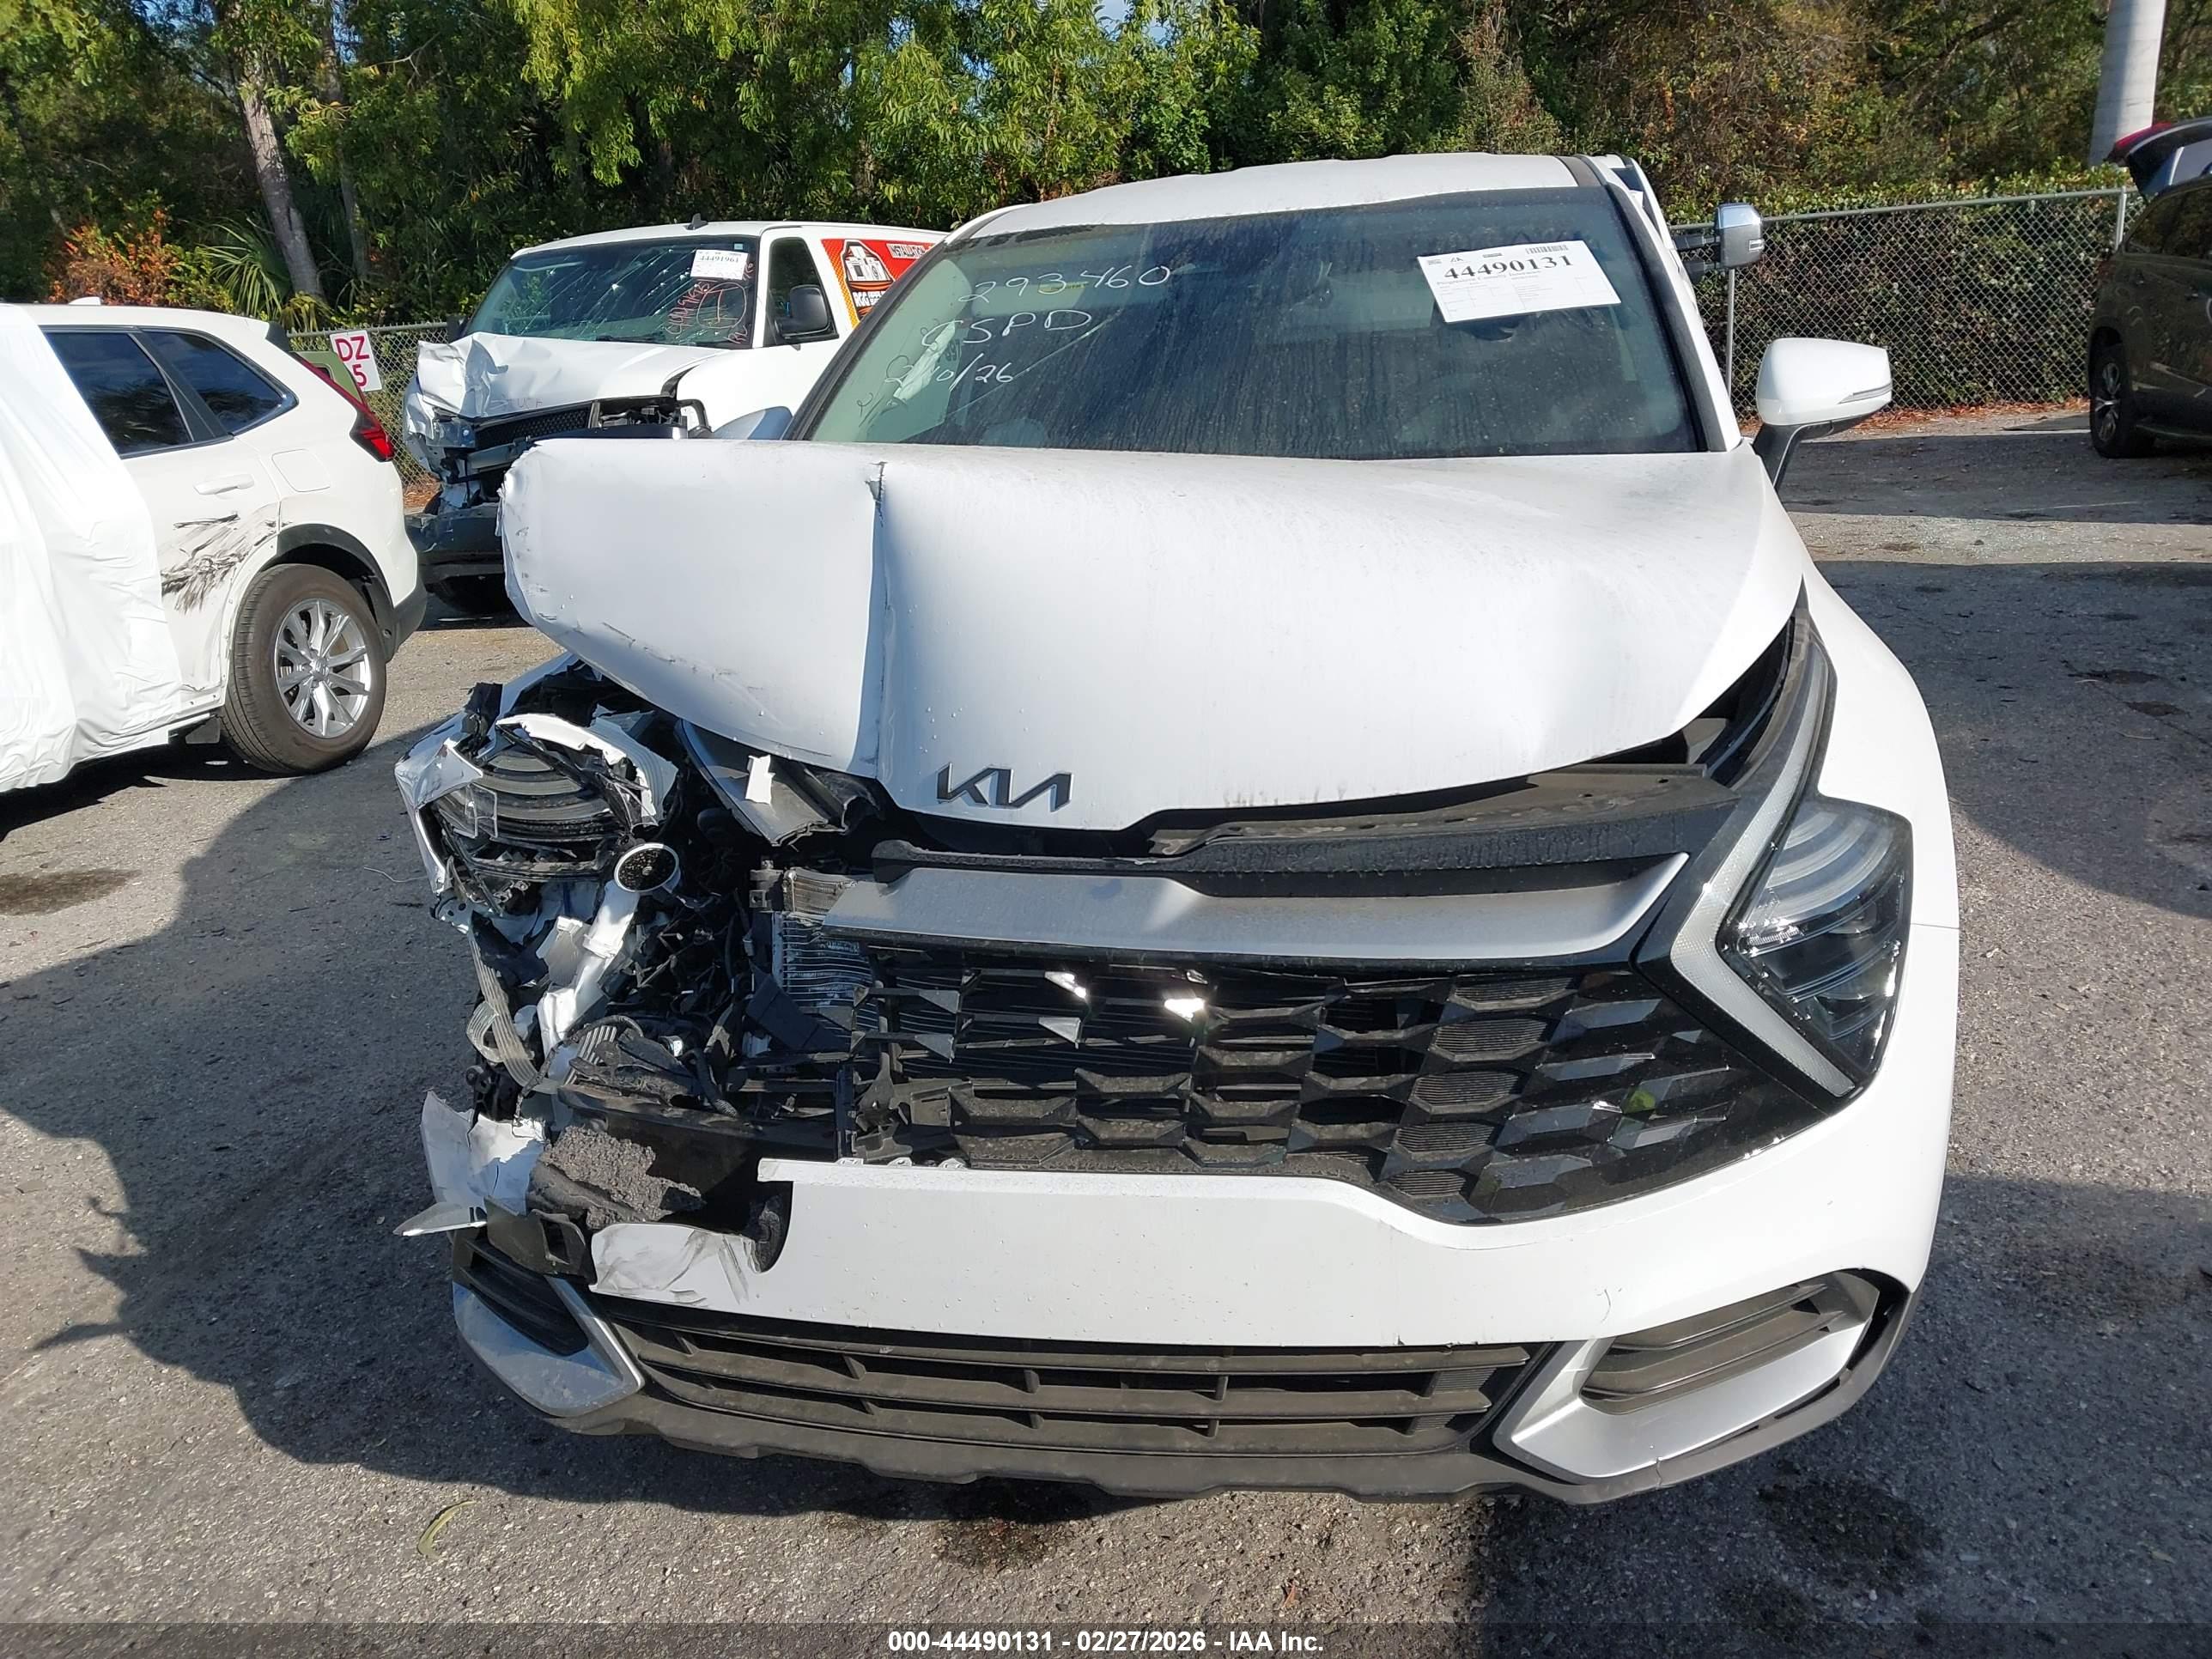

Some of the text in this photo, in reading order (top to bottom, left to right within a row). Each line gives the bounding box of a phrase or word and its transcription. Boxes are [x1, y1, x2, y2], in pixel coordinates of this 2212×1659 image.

[1444, 254, 1574, 280] 44490131
[957, 264, 1170, 303] 293460
[335, 336, 370, 362] DZ
[352, 364, 368, 386] 5
[937, 763, 1074, 812] KIA
